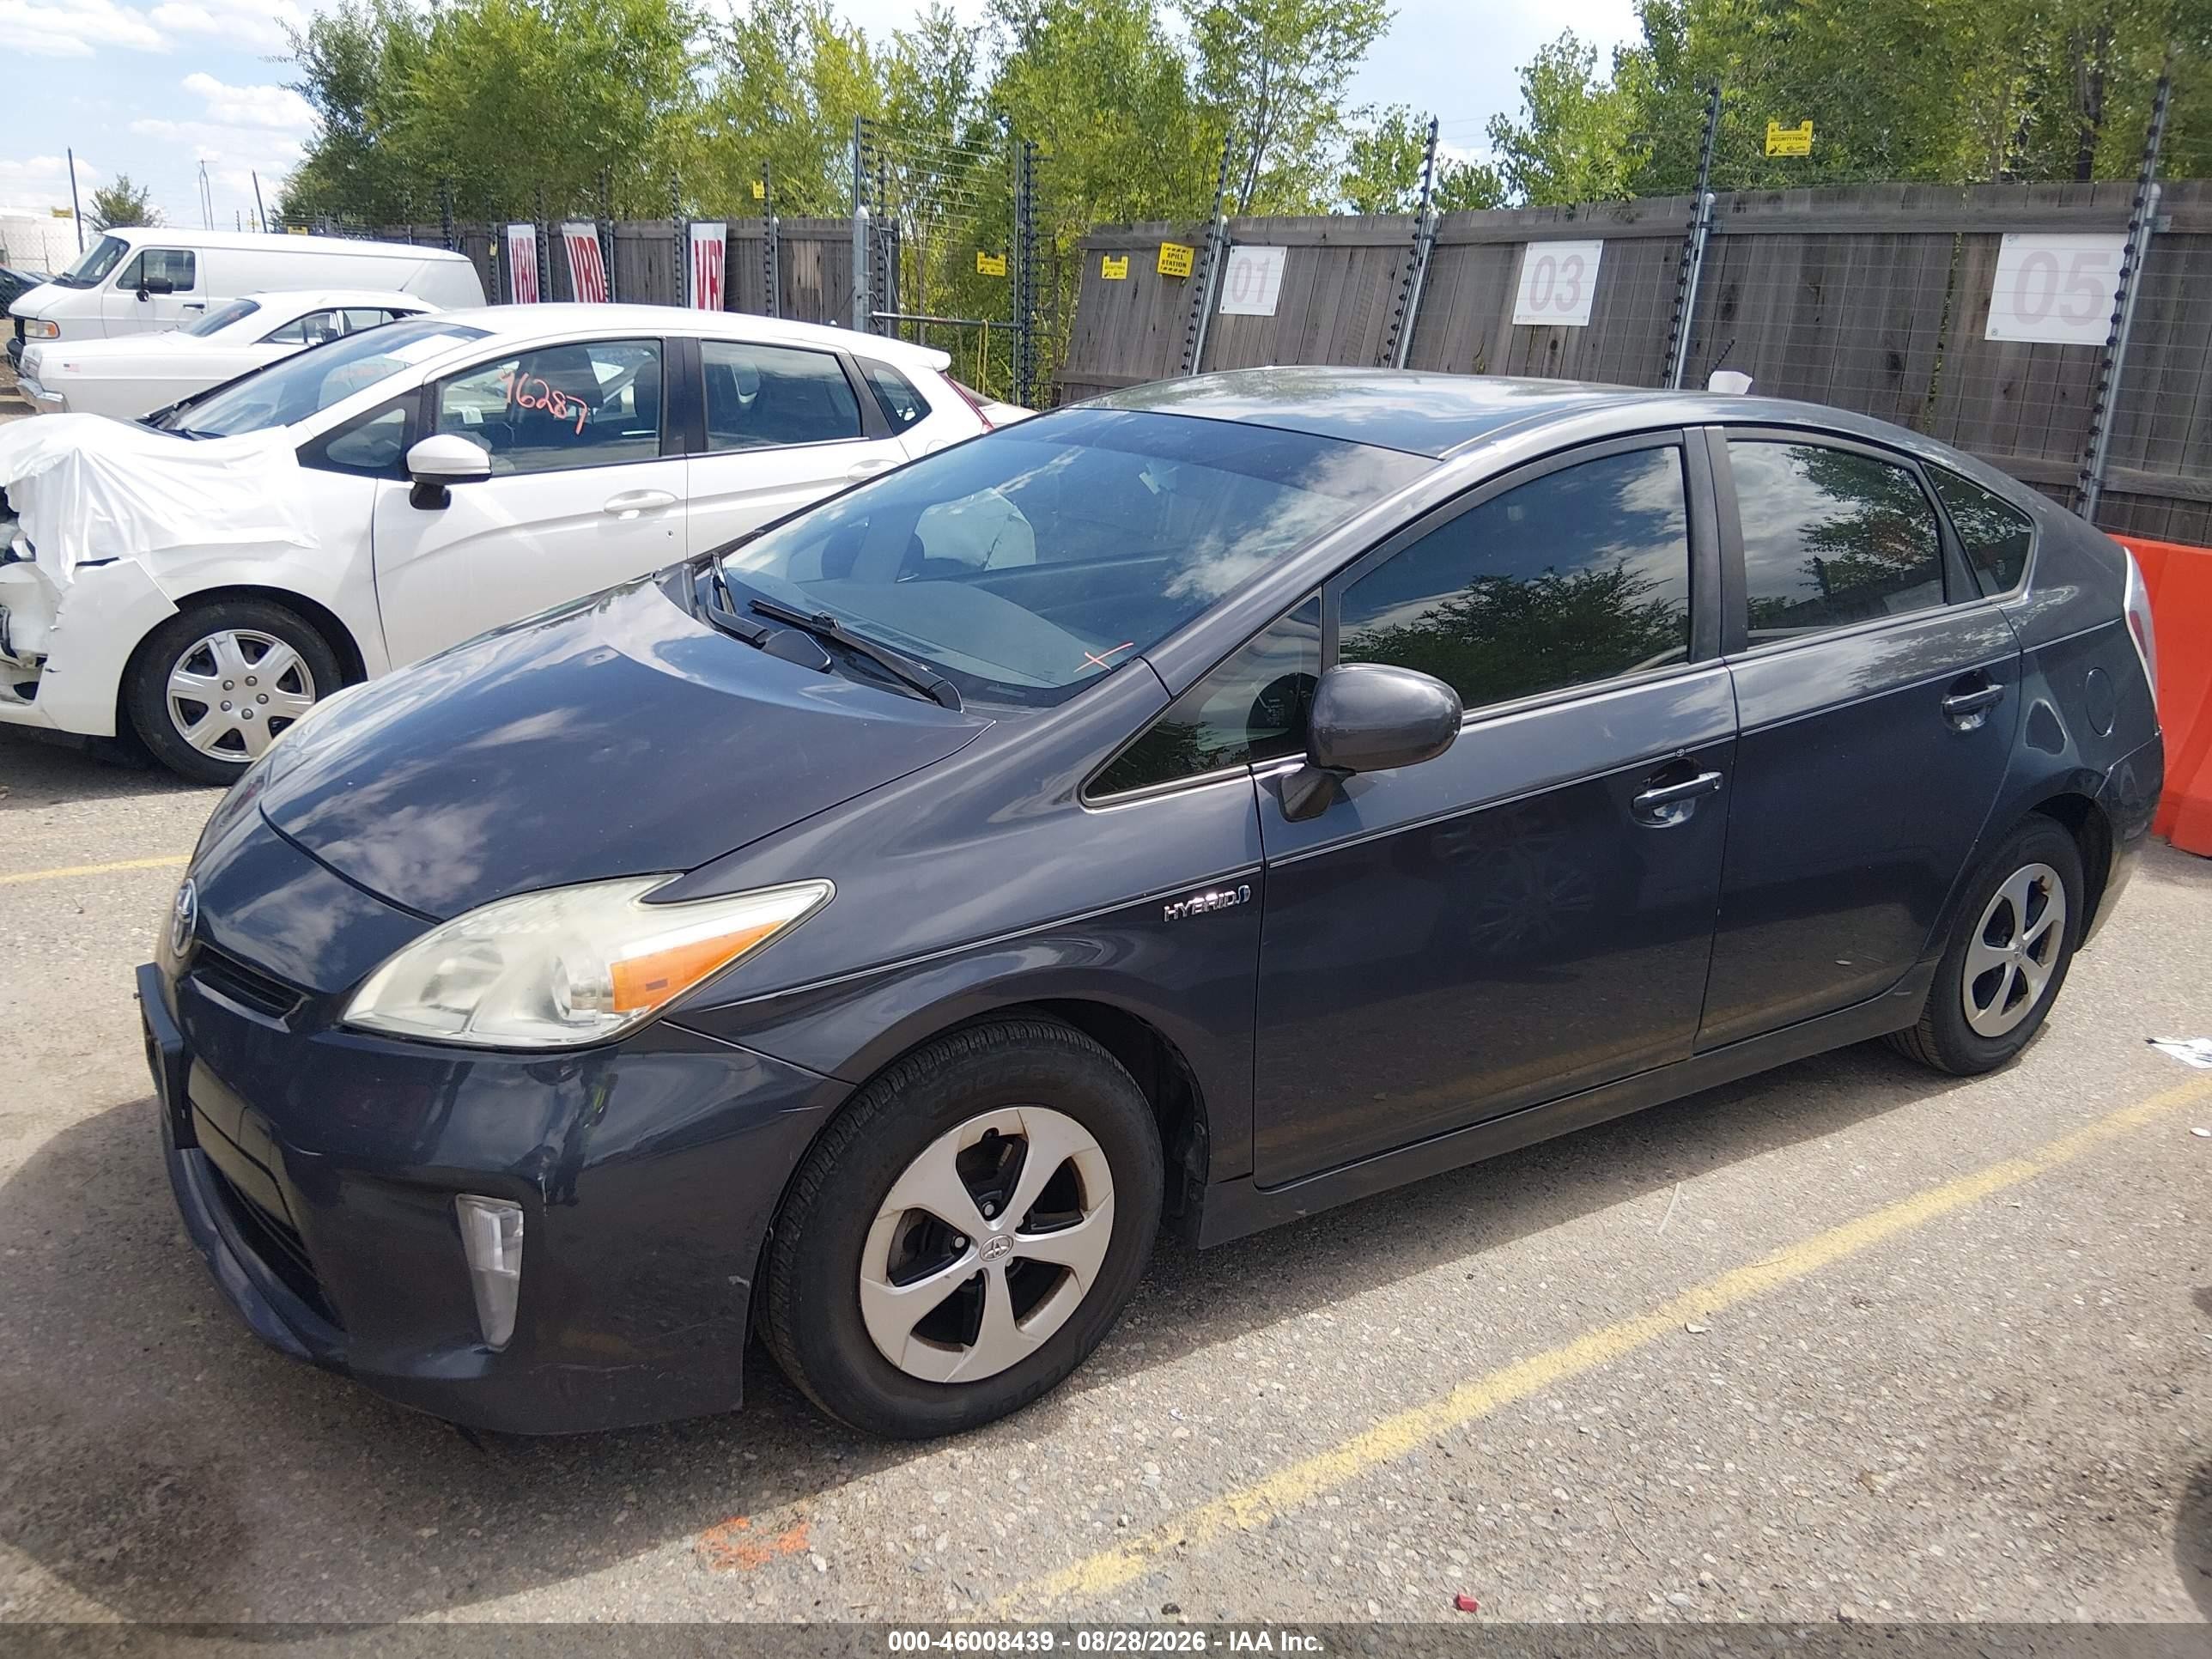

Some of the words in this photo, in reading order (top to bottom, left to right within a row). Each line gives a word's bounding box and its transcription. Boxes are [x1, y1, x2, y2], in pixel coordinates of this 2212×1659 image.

[1161, 259, 1187, 268] STATION
[1167, 252, 1183, 260] SPILL
[1231, 256, 1271, 303] 01
[1529, 254, 1585, 312] 03
[2013, 250, 2111, 326] 05
[1164, 890, 1237, 922] HYBRID
